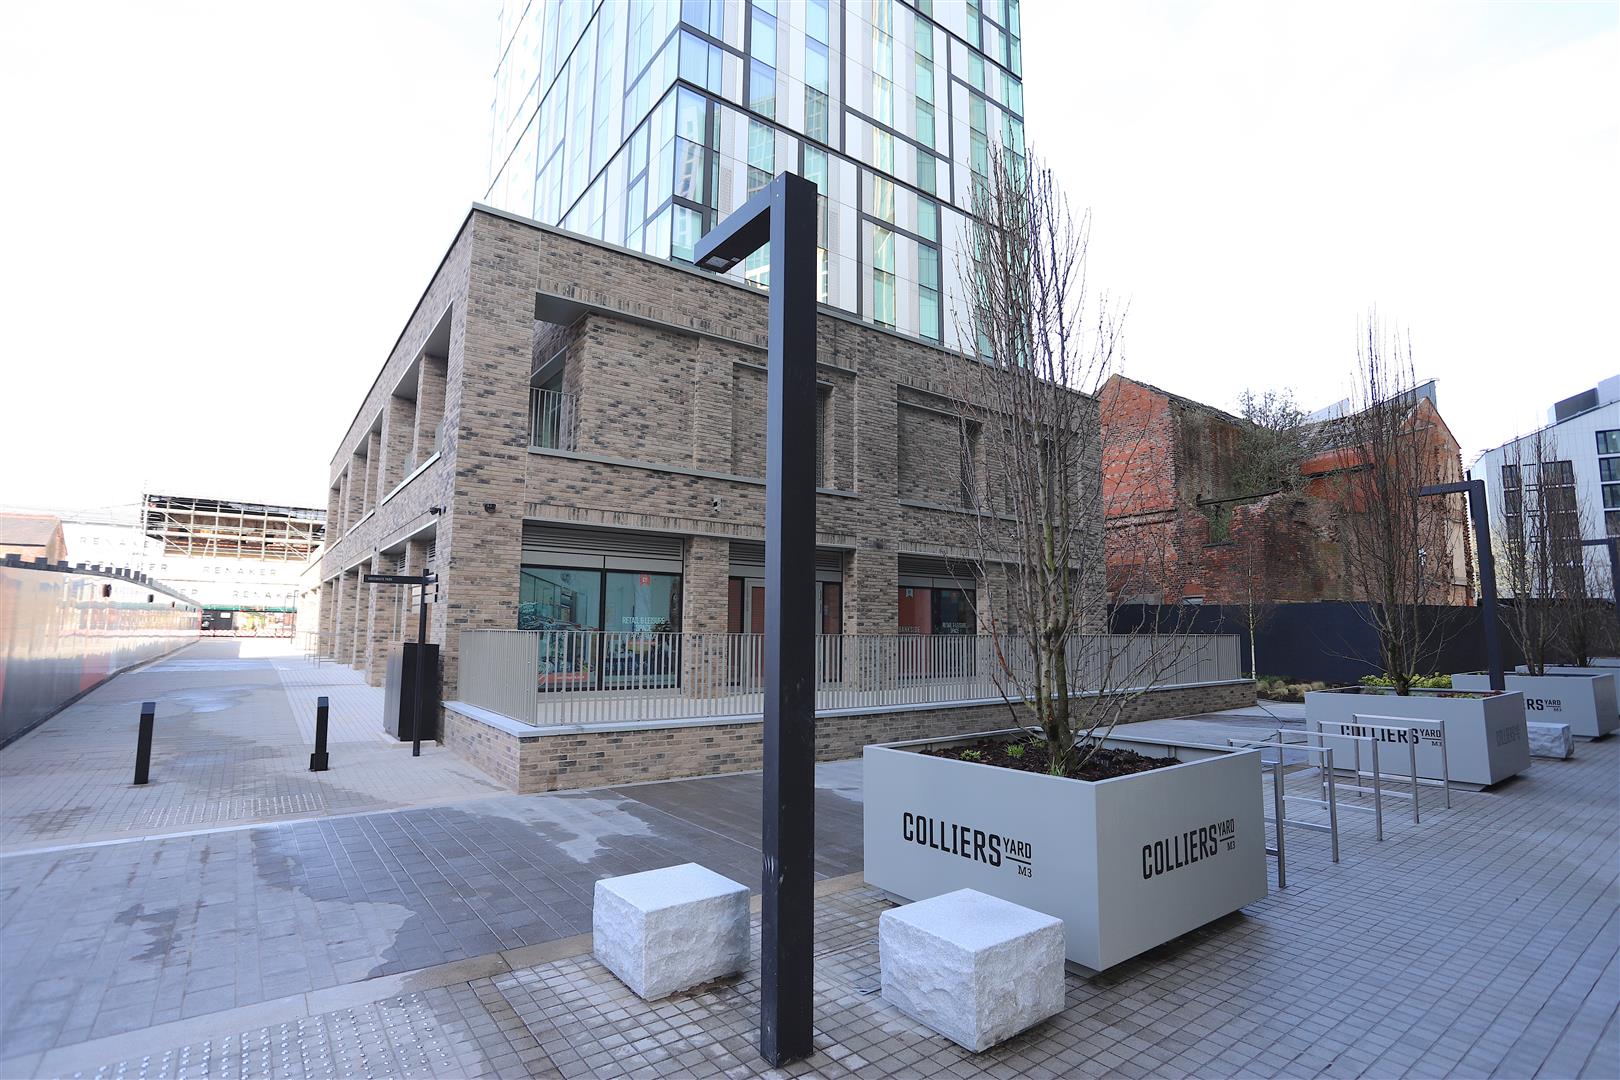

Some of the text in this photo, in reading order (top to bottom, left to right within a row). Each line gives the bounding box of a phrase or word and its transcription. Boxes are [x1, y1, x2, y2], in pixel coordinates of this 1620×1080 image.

[1420, 728, 1441, 738] YARD
[903, 812, 1032, 867] COLLIERS YARD
[1227, 841, 1236, 851] M3
[1142, 818, 1235, 880] COLLIERS YARD
[1018, 865, 1033, 878] M3
